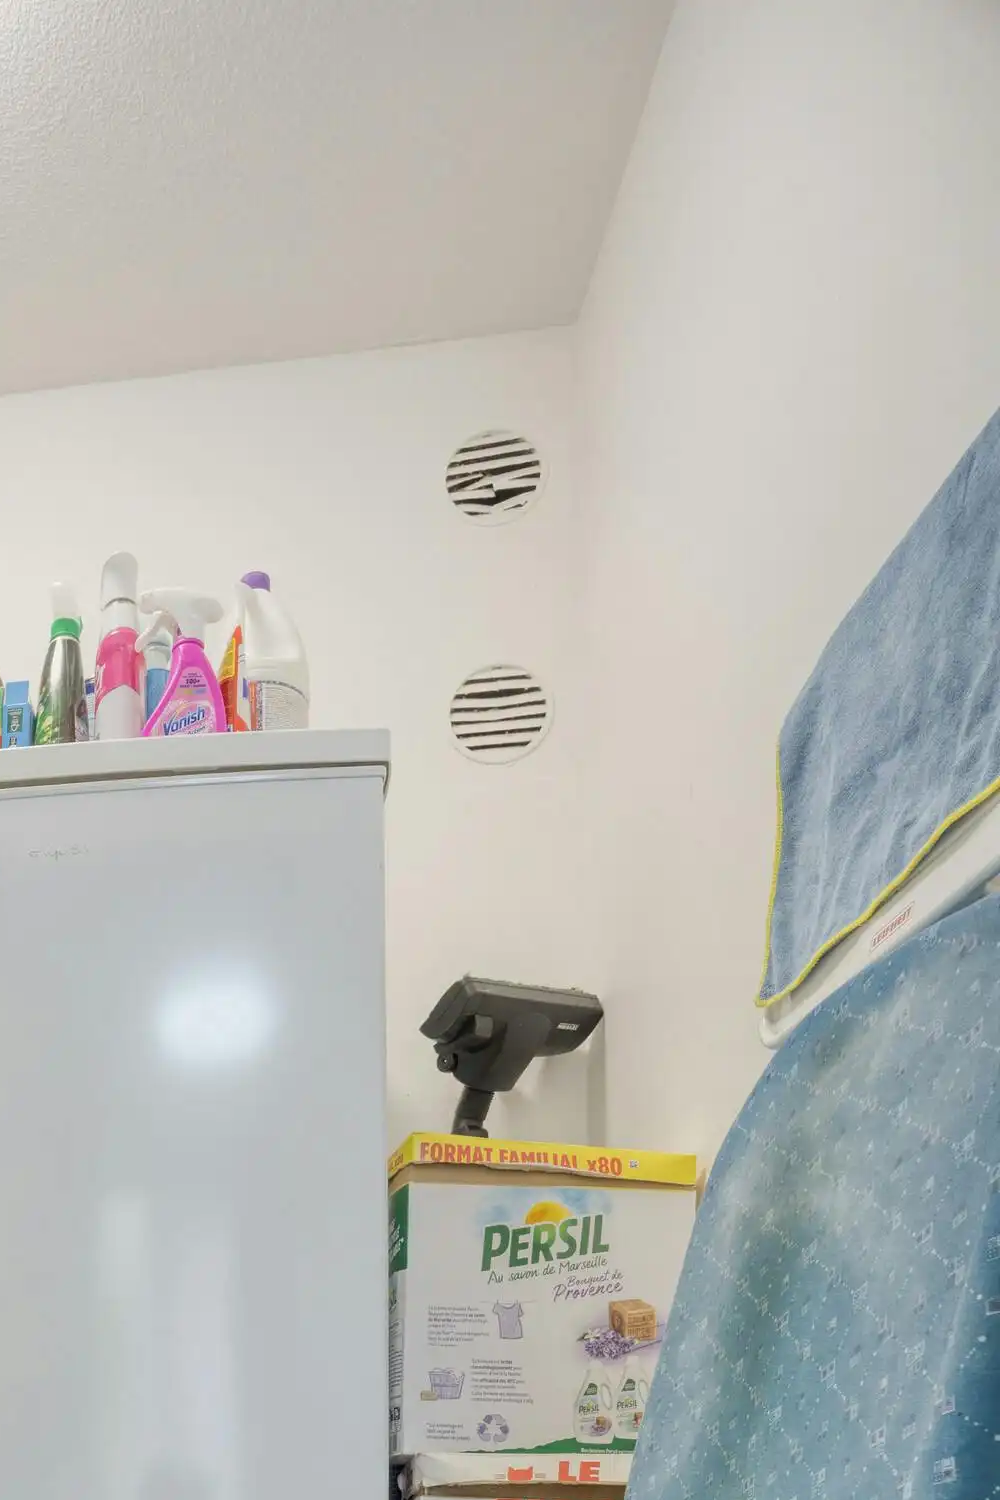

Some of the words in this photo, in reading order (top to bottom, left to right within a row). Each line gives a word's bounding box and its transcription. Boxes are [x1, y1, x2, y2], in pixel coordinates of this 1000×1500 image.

[163, 706, 205, 736] Vanish
[420, 1142, 493, 1164] FORMAT
[587, 1156, 623, 1177] x80
[481, 1214, 610, 1272] PERSIL
[487, 1270, 504, 1285] Au
[508, 1269, 539, 1282] savon
[542, 1263, 556, 1275] de
[558, 1255, 608, 1275] Marseille
[567, 1271, 609, 1288] Bouquet
[611, 1272, 624, 1281] de
[552, 1282, 624, 1302] Provence
[558, 1460, 601, 1482] LE
